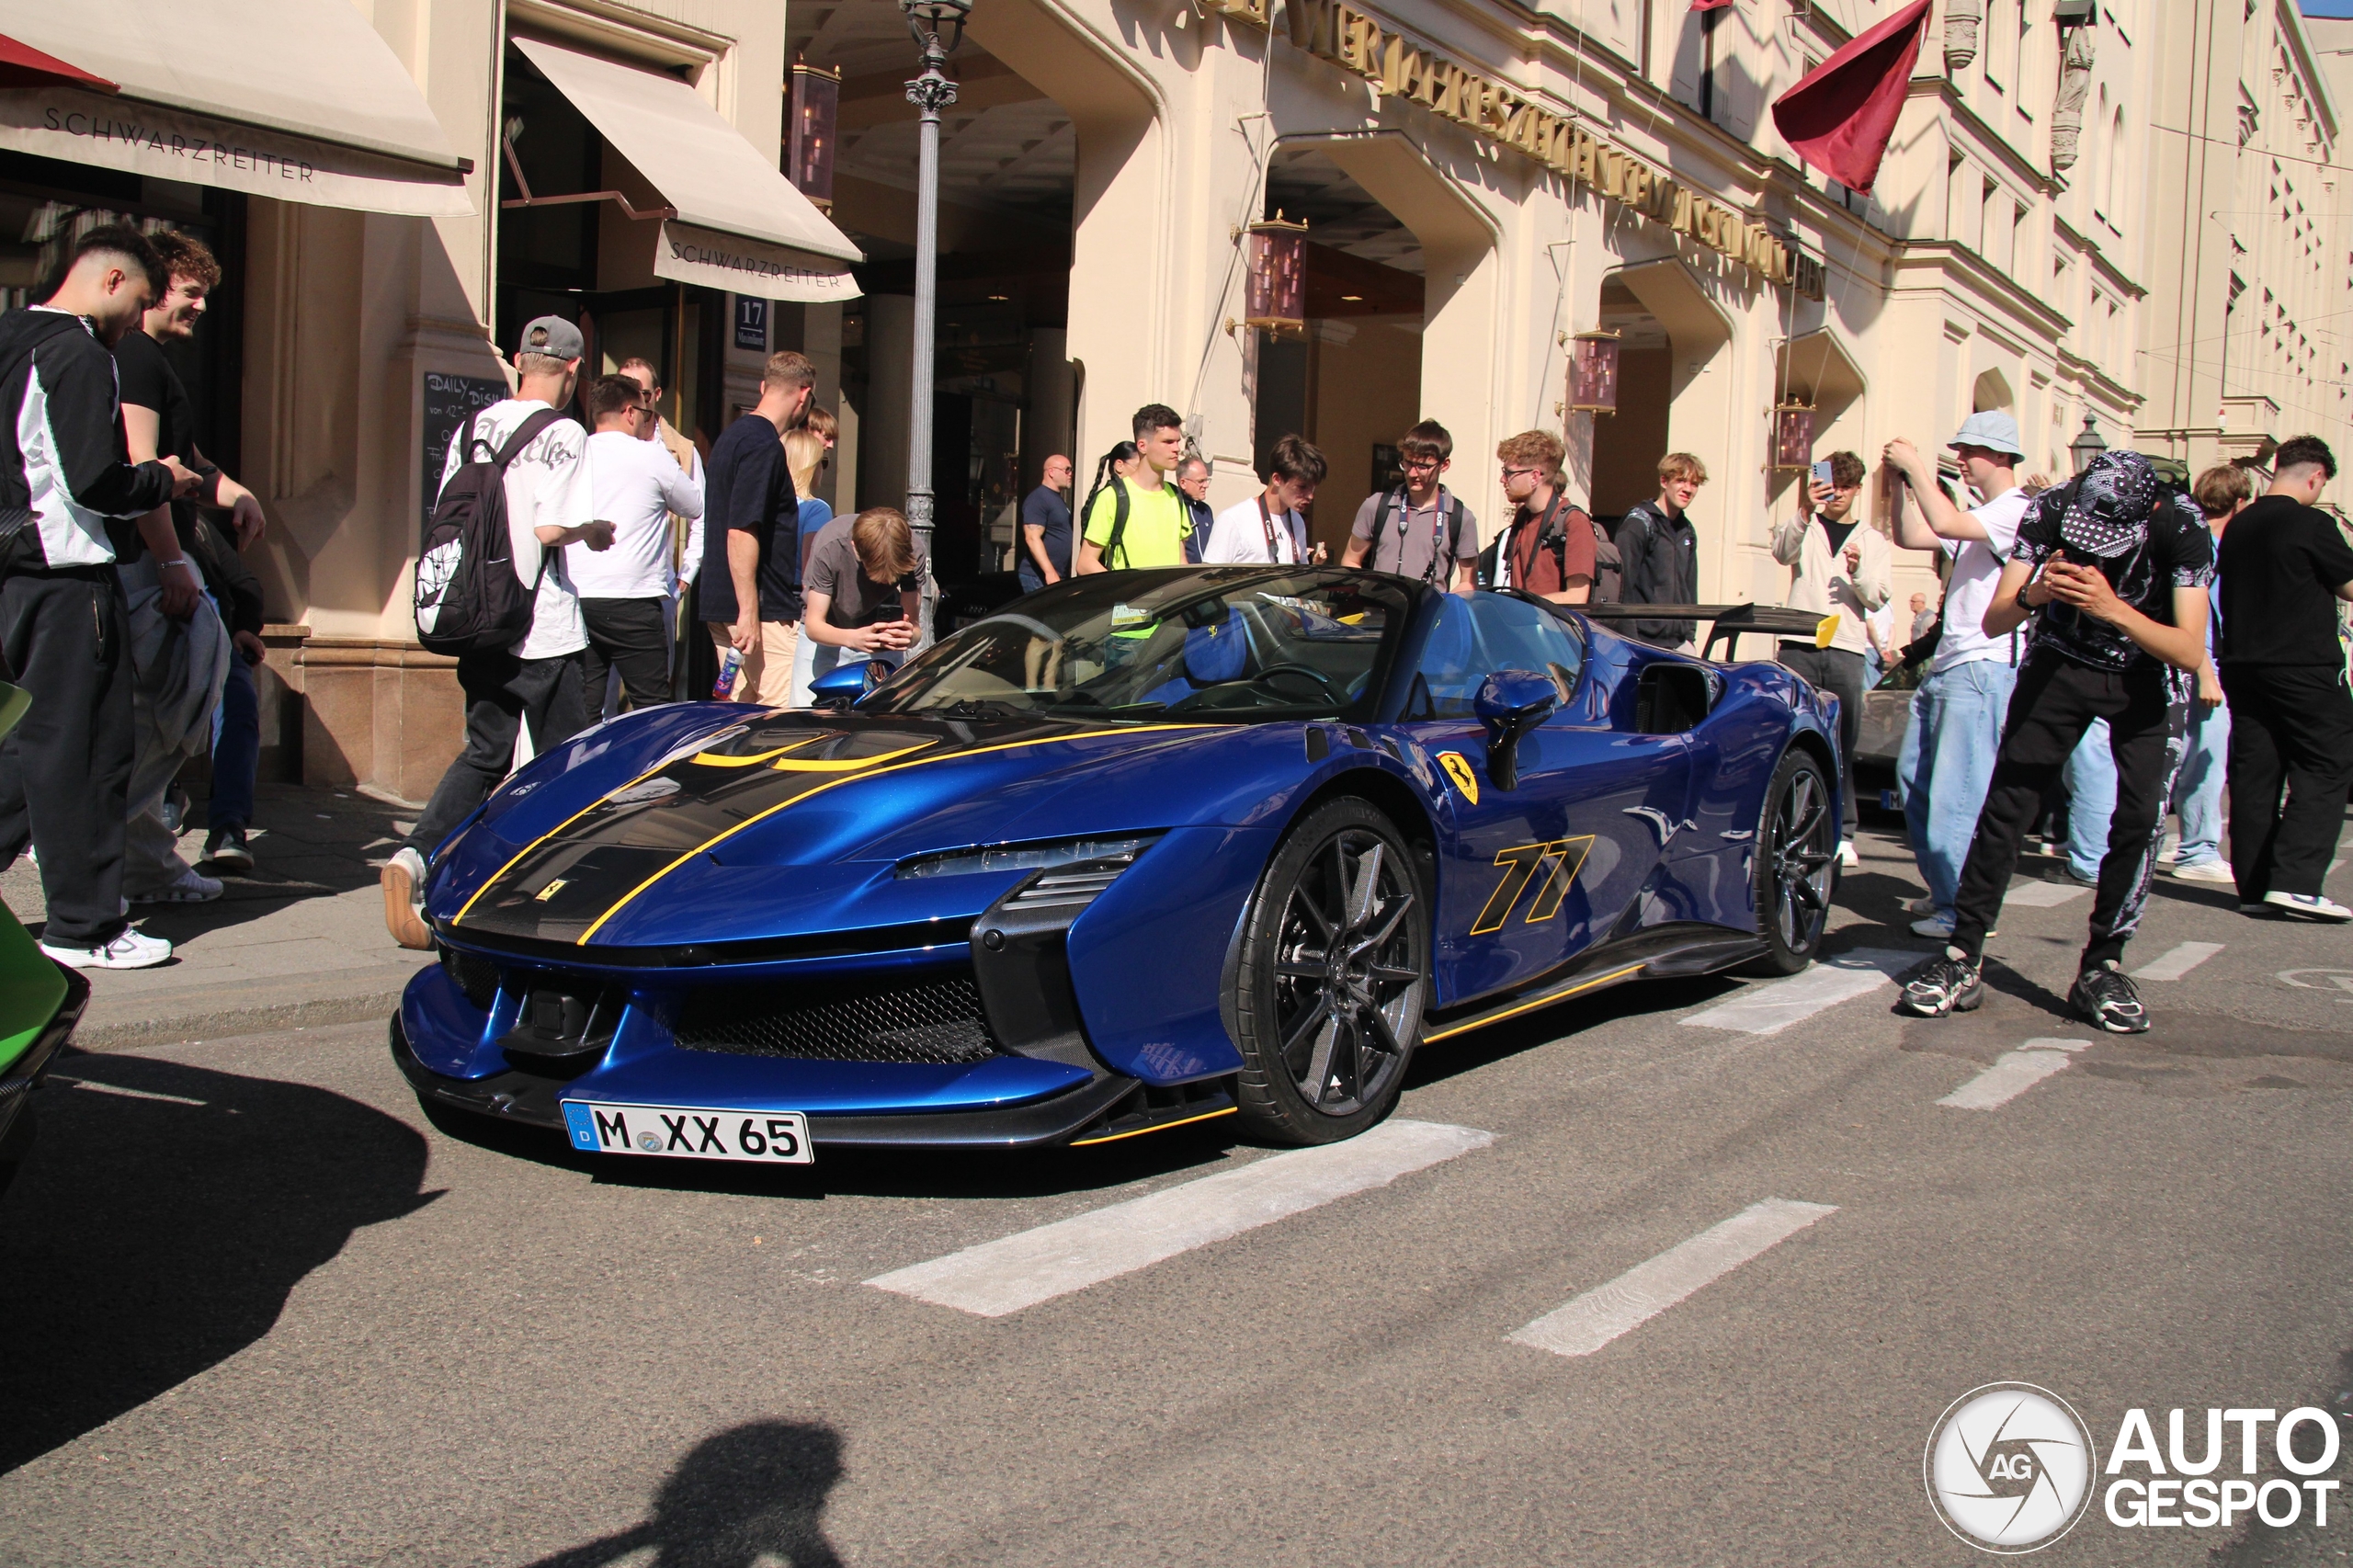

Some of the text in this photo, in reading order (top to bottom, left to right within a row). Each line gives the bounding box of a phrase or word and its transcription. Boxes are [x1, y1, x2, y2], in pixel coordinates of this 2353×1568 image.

[44, 108, 313, 183] SCHWARZREITER
[1377, 31, 1611, 196] JAHRESZEITEN
[1607, 151, 1745, 264] KEMPINSKI
[670, 242, 841, 288] SCHWARZREITER
[743, 301, 763, 324] 17
[1470, 835, 1596, 936] 77
[580, 1110, 799, 1156] D M XX 65
